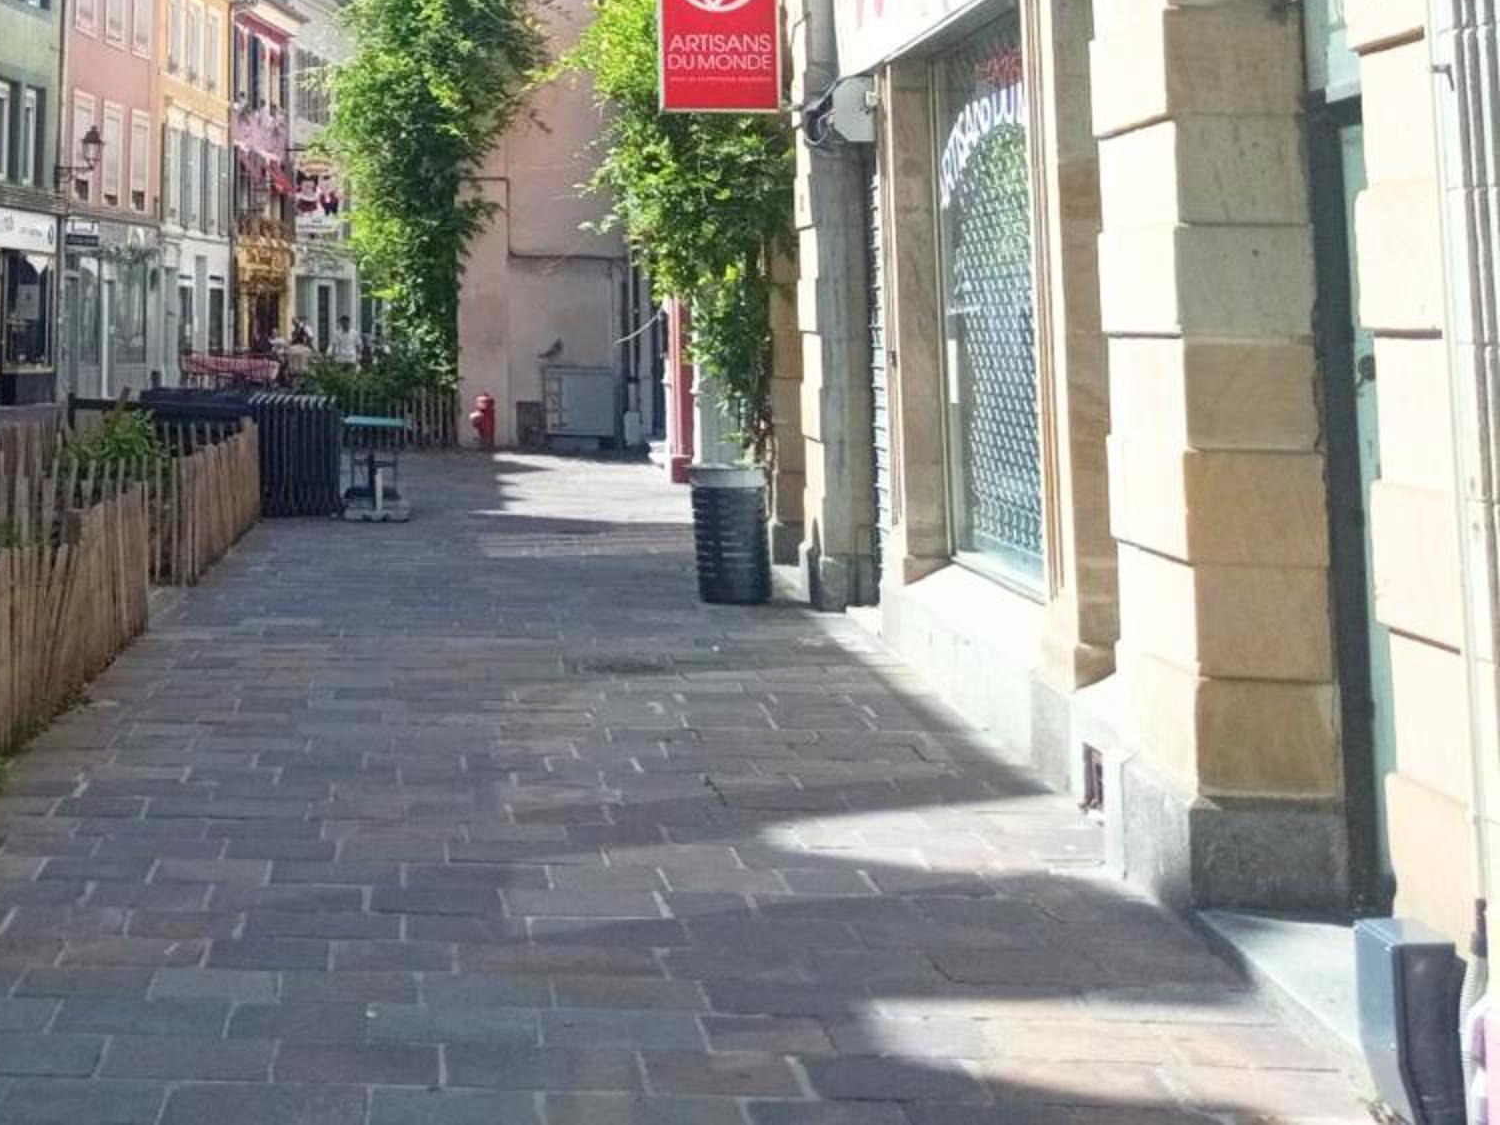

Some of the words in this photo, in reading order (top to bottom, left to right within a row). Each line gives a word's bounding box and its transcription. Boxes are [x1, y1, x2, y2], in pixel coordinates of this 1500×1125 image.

[668, 34, 772, 52] ARTISANS
[667, 54, 695, 70] DU
[697, 54, 773, 70] MONDE
